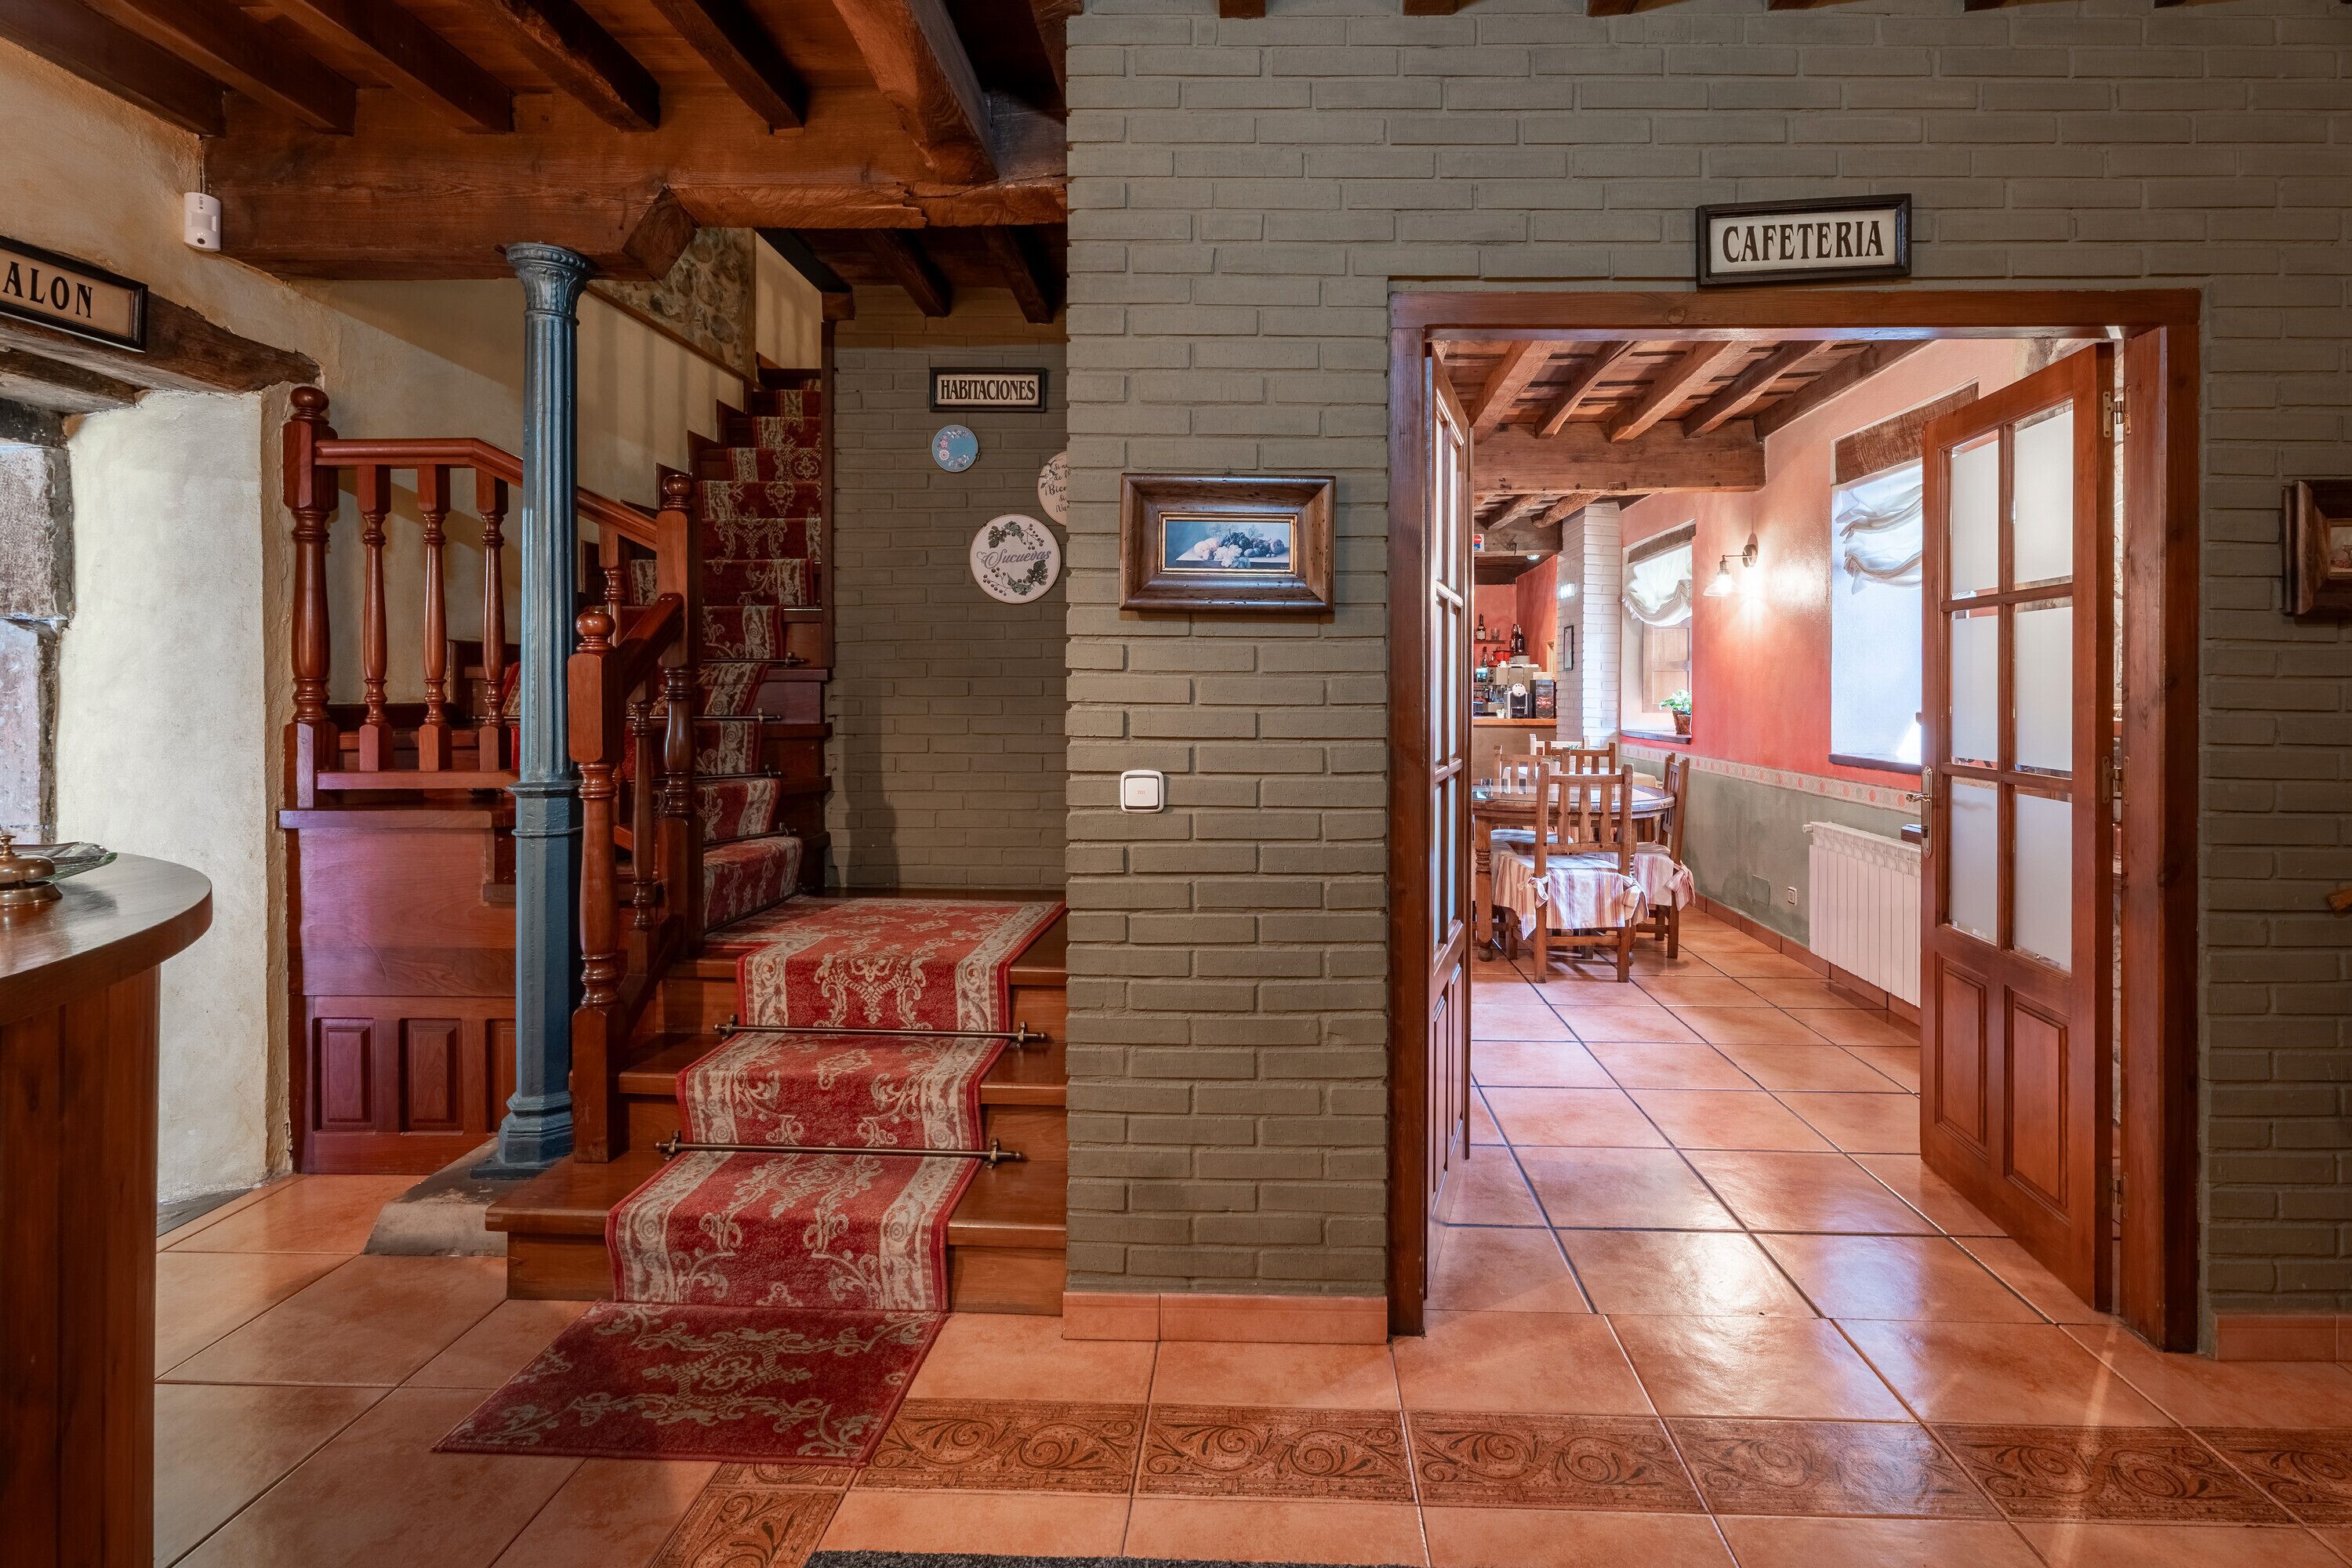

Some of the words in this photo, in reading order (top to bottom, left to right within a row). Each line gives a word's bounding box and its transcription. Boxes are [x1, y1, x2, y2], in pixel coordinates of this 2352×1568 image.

[1722, 220, 1884, 263] CAFETERIA
[2, 261, 93, 318] ALON
[940, 379, 1036, 401] HABITACIONES
[983, 549, 1051, 568] Sucuevas
